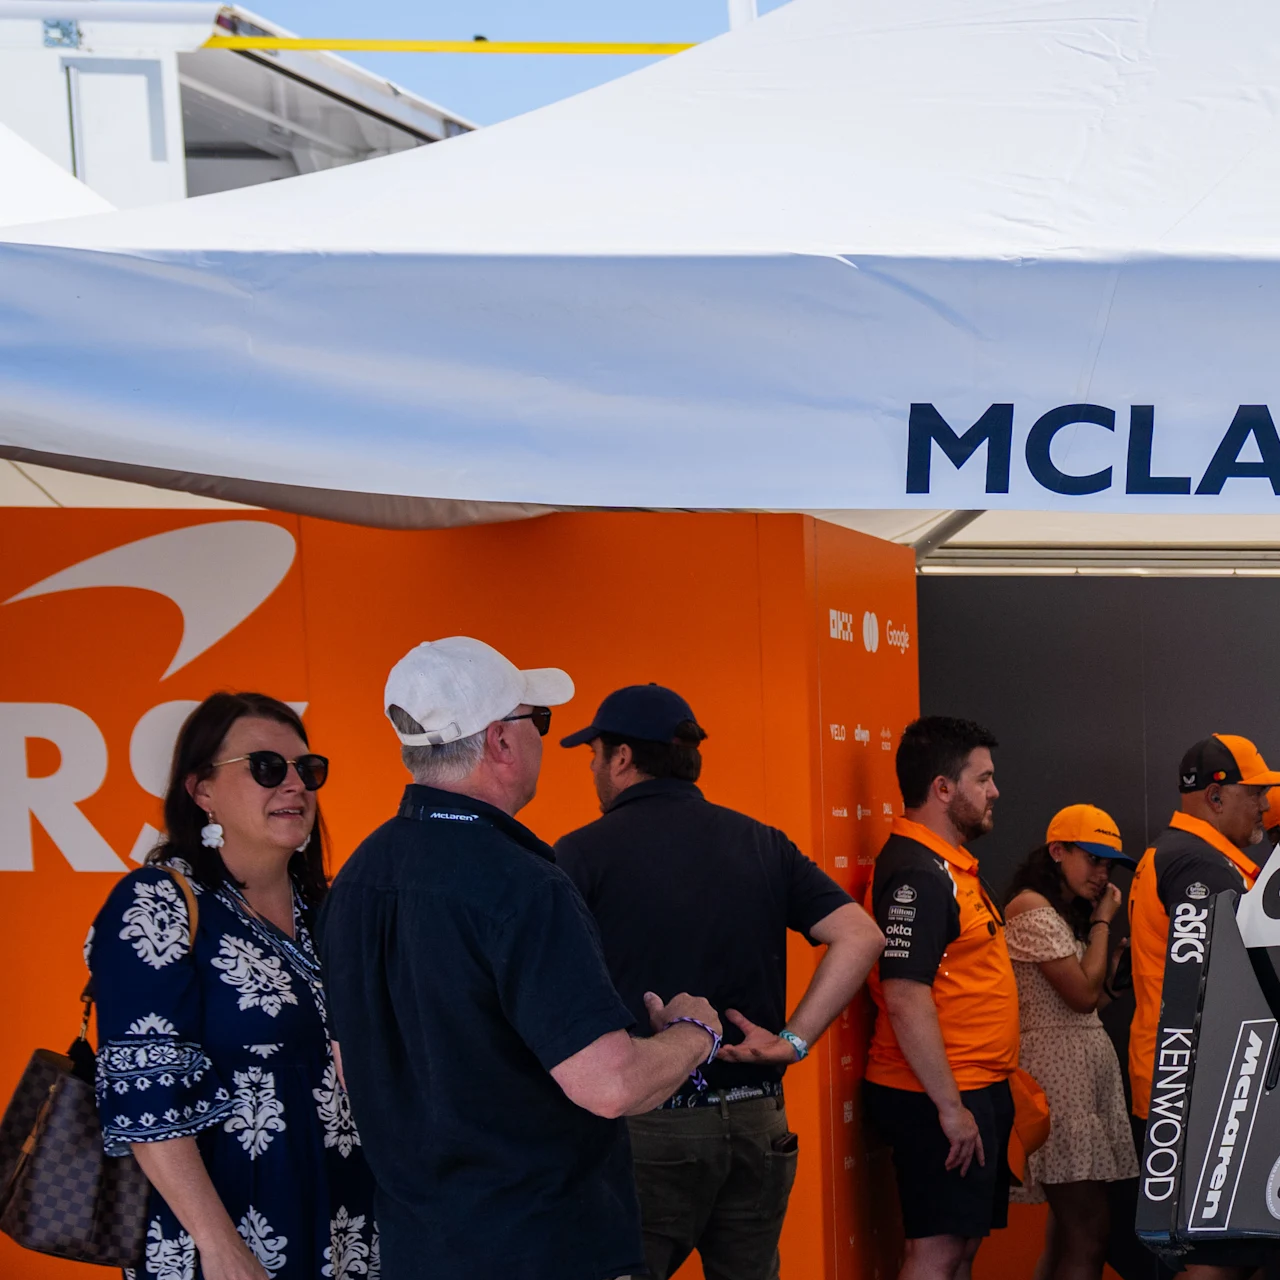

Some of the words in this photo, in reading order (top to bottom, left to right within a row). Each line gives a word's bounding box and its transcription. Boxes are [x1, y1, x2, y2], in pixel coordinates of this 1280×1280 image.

[886, 619, 909, 654] Google
[430, 811, 472, 822] McLaren
[891, 908, 913, 916] Hilton
[885, 938, 911, 948] FxPro
[886, 924, 912, 936] okta
[1170, 902, 1208, 964] asics
[282, 940, 314, 969] McLaren
[1144, 1027, 1194, 1201] KENWOOD
[1202, 1029, 1263, 1219] McLaren
